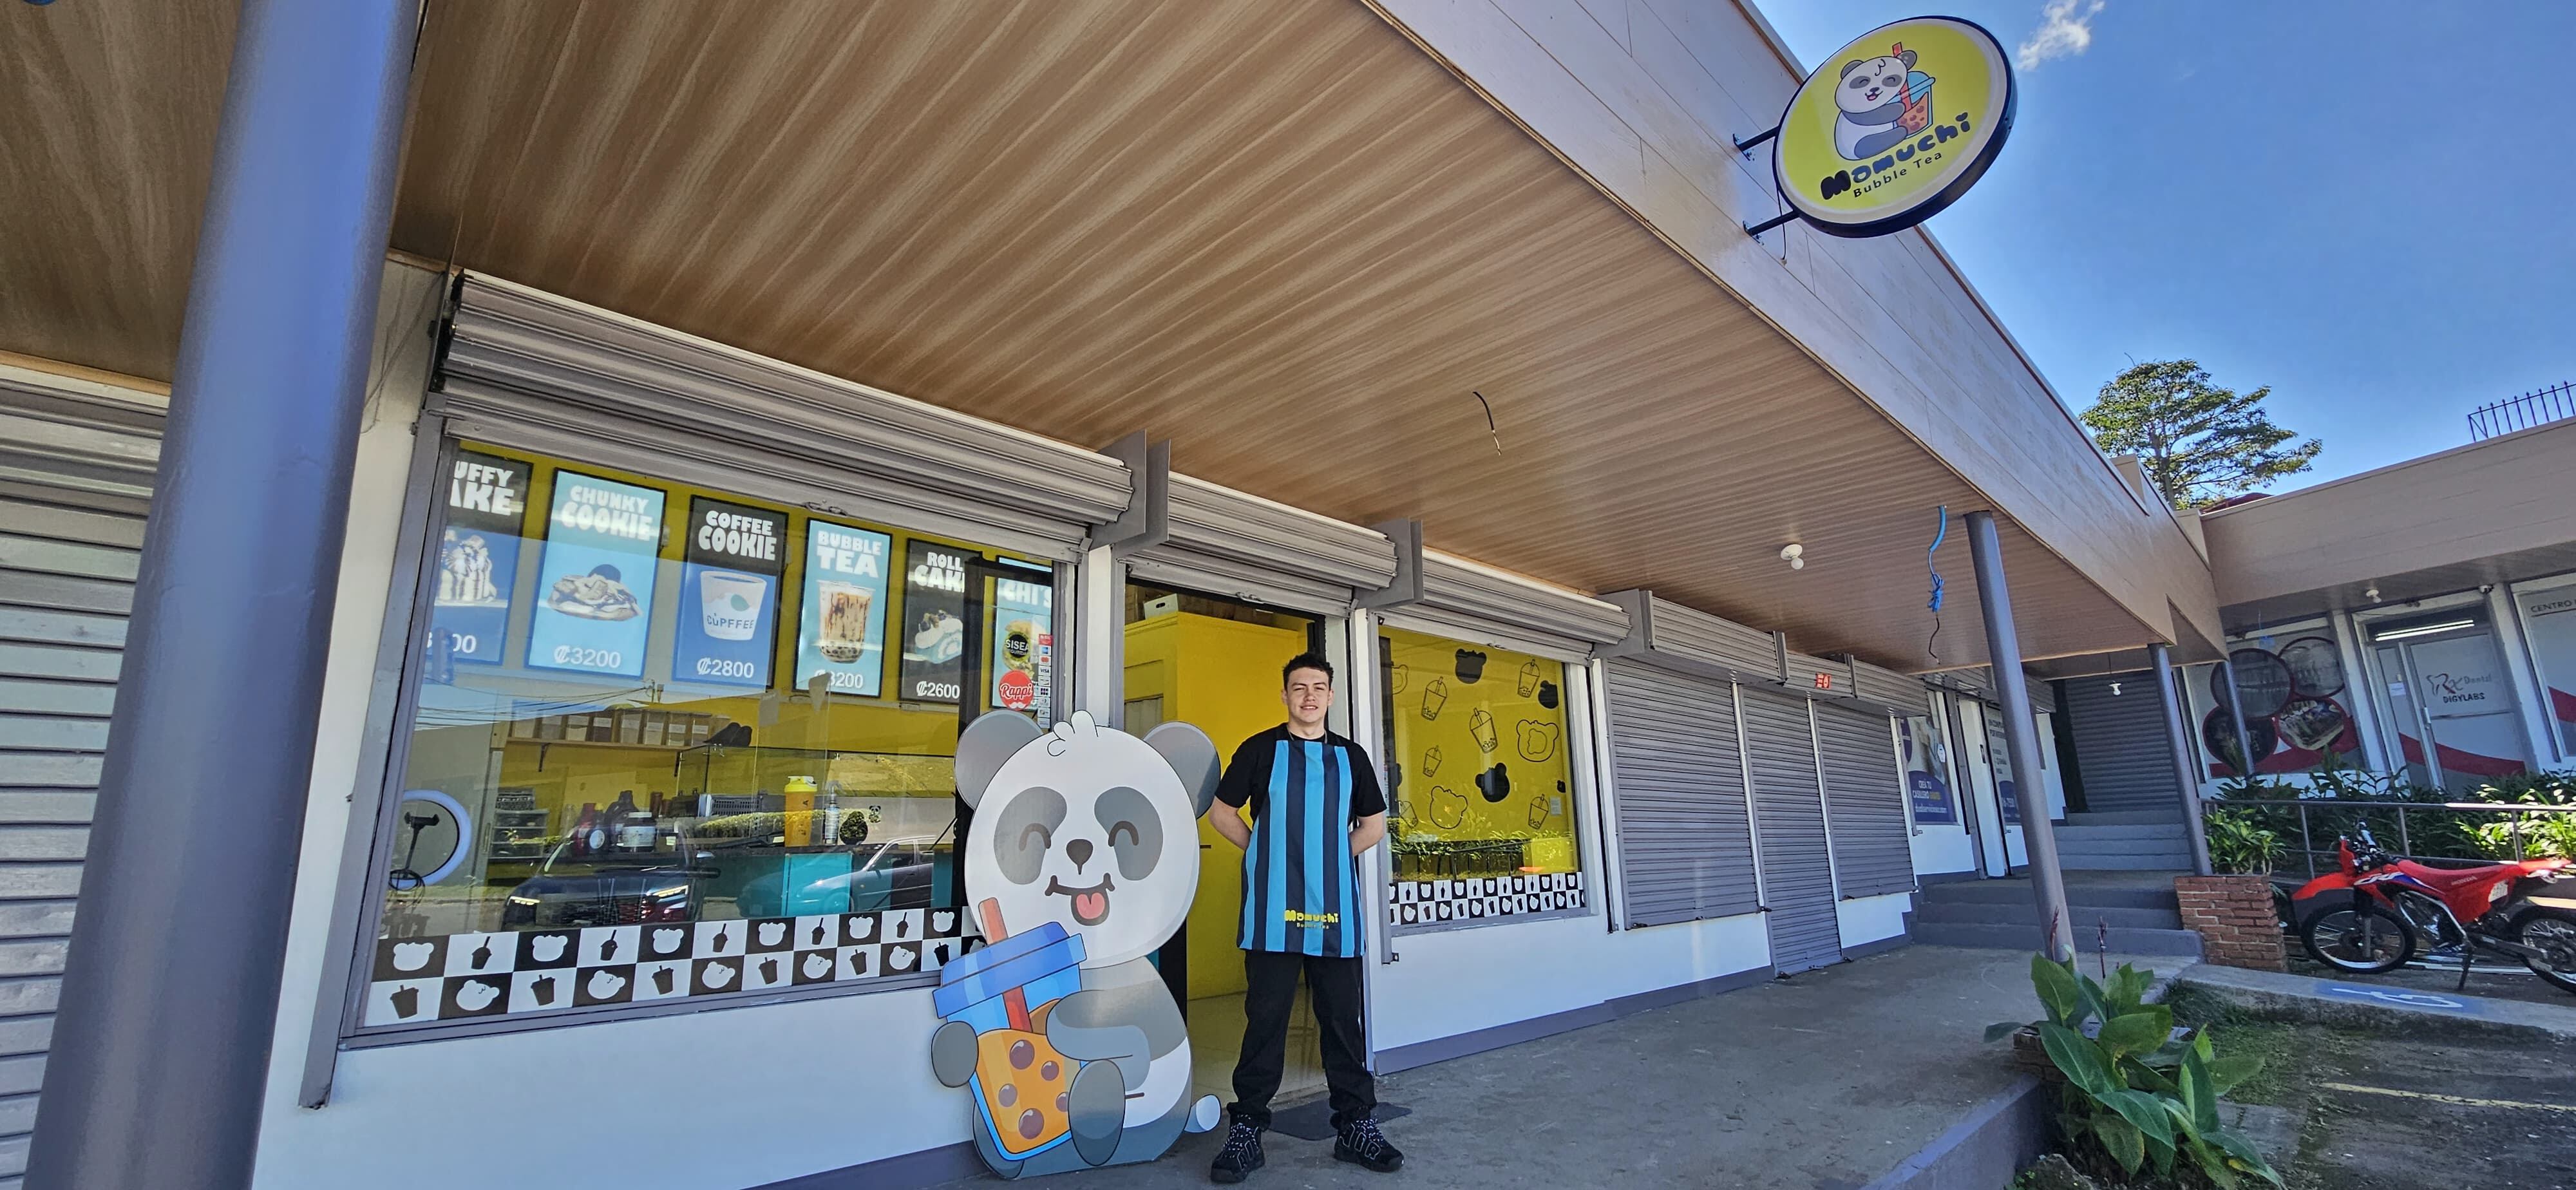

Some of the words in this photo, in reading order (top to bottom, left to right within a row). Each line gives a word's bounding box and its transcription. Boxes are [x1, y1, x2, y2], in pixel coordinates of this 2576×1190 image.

[1820, 112, 1971, 200] Momuchi
[1853, 168, 1908, 198] Bubble
[1913, 152, 1943, 169] Tea
[569, 484, 650, 513] CHUNKY
[560, 501, 654, 542] COOKIE
[705, 509, 773, 537] COFFEE
[697, 524, 777, 561] COOKIE
[817, 530, 882, 556] BUBBLE
[815, 548, 879, 578] TEA
[927, 551, 963, 572] ROLL
[2530, 600, 2572, 613] CENTRO
[999, 683, 1033, 700] Rappi
[2443, 692, 2485, 704] DIGYLABS
[1284, 909, 1338, 923] Momuchi
